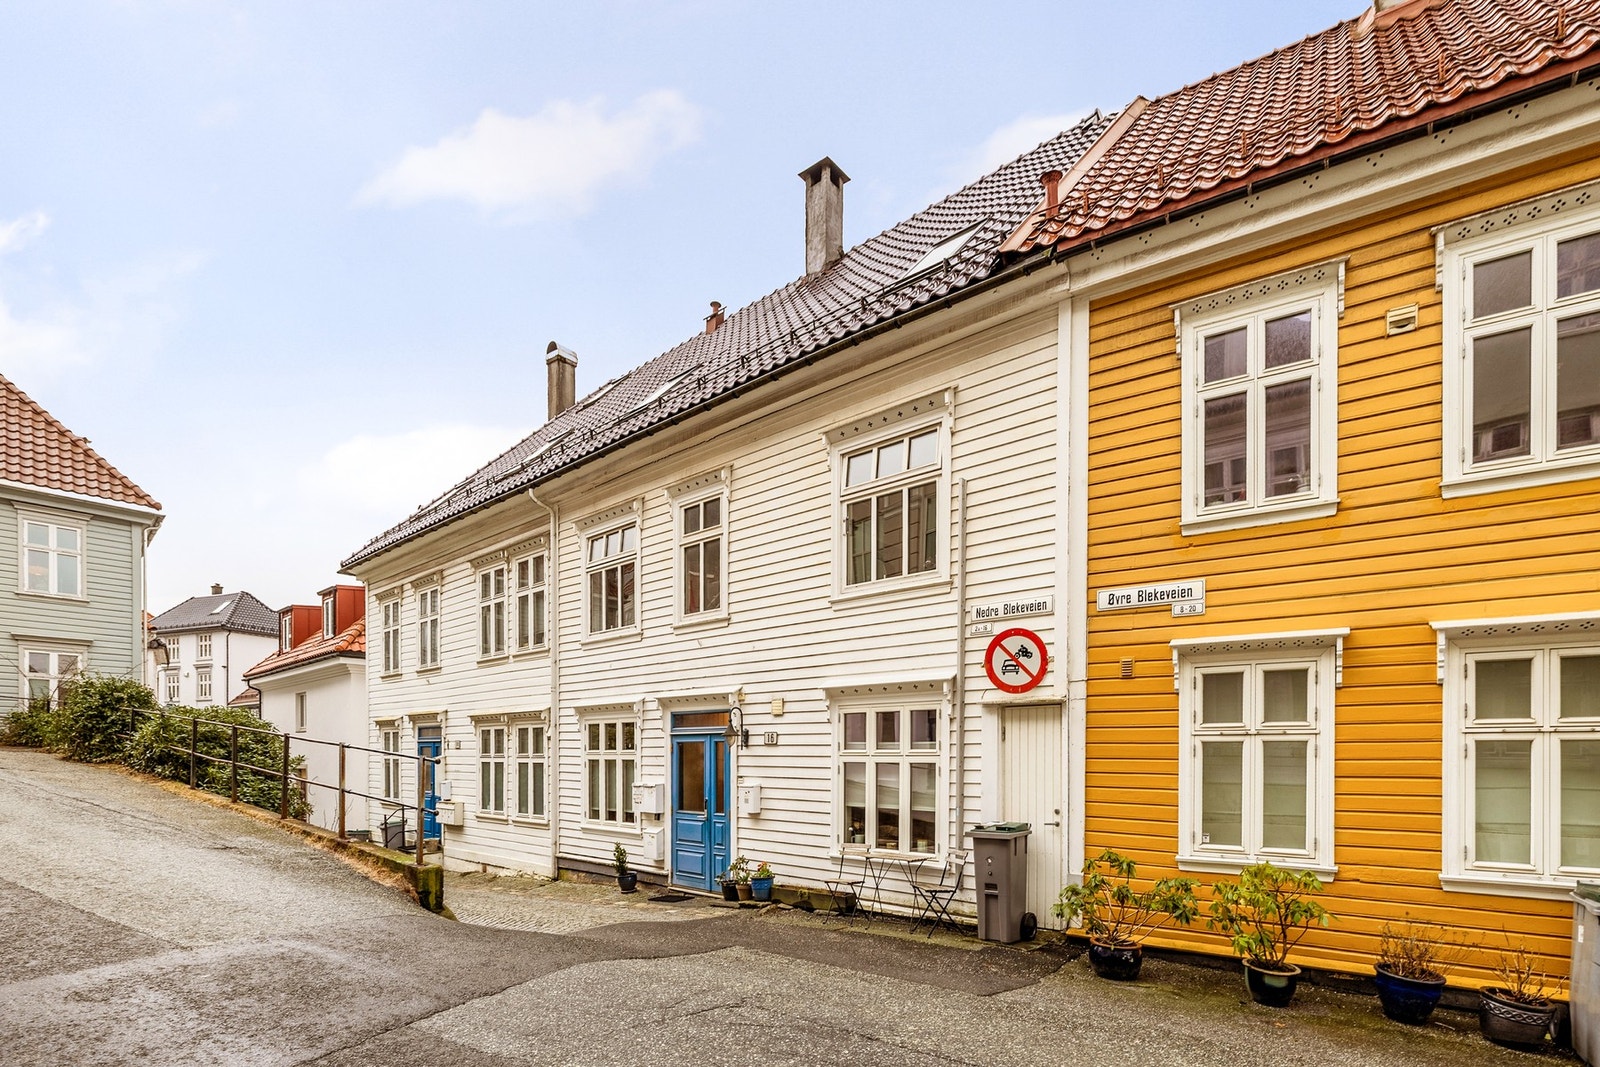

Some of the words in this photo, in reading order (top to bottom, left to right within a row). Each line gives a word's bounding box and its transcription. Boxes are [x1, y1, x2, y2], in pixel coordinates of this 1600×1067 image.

[1108, 593, 1132, 606] Øvre
[1137, 586, 1193, 603] Blekeveien
[975, 606, 999, 619] Nedre
[1003, 599, 1047, 615] Blekeveien
[767, 733, 775, 743] 16
